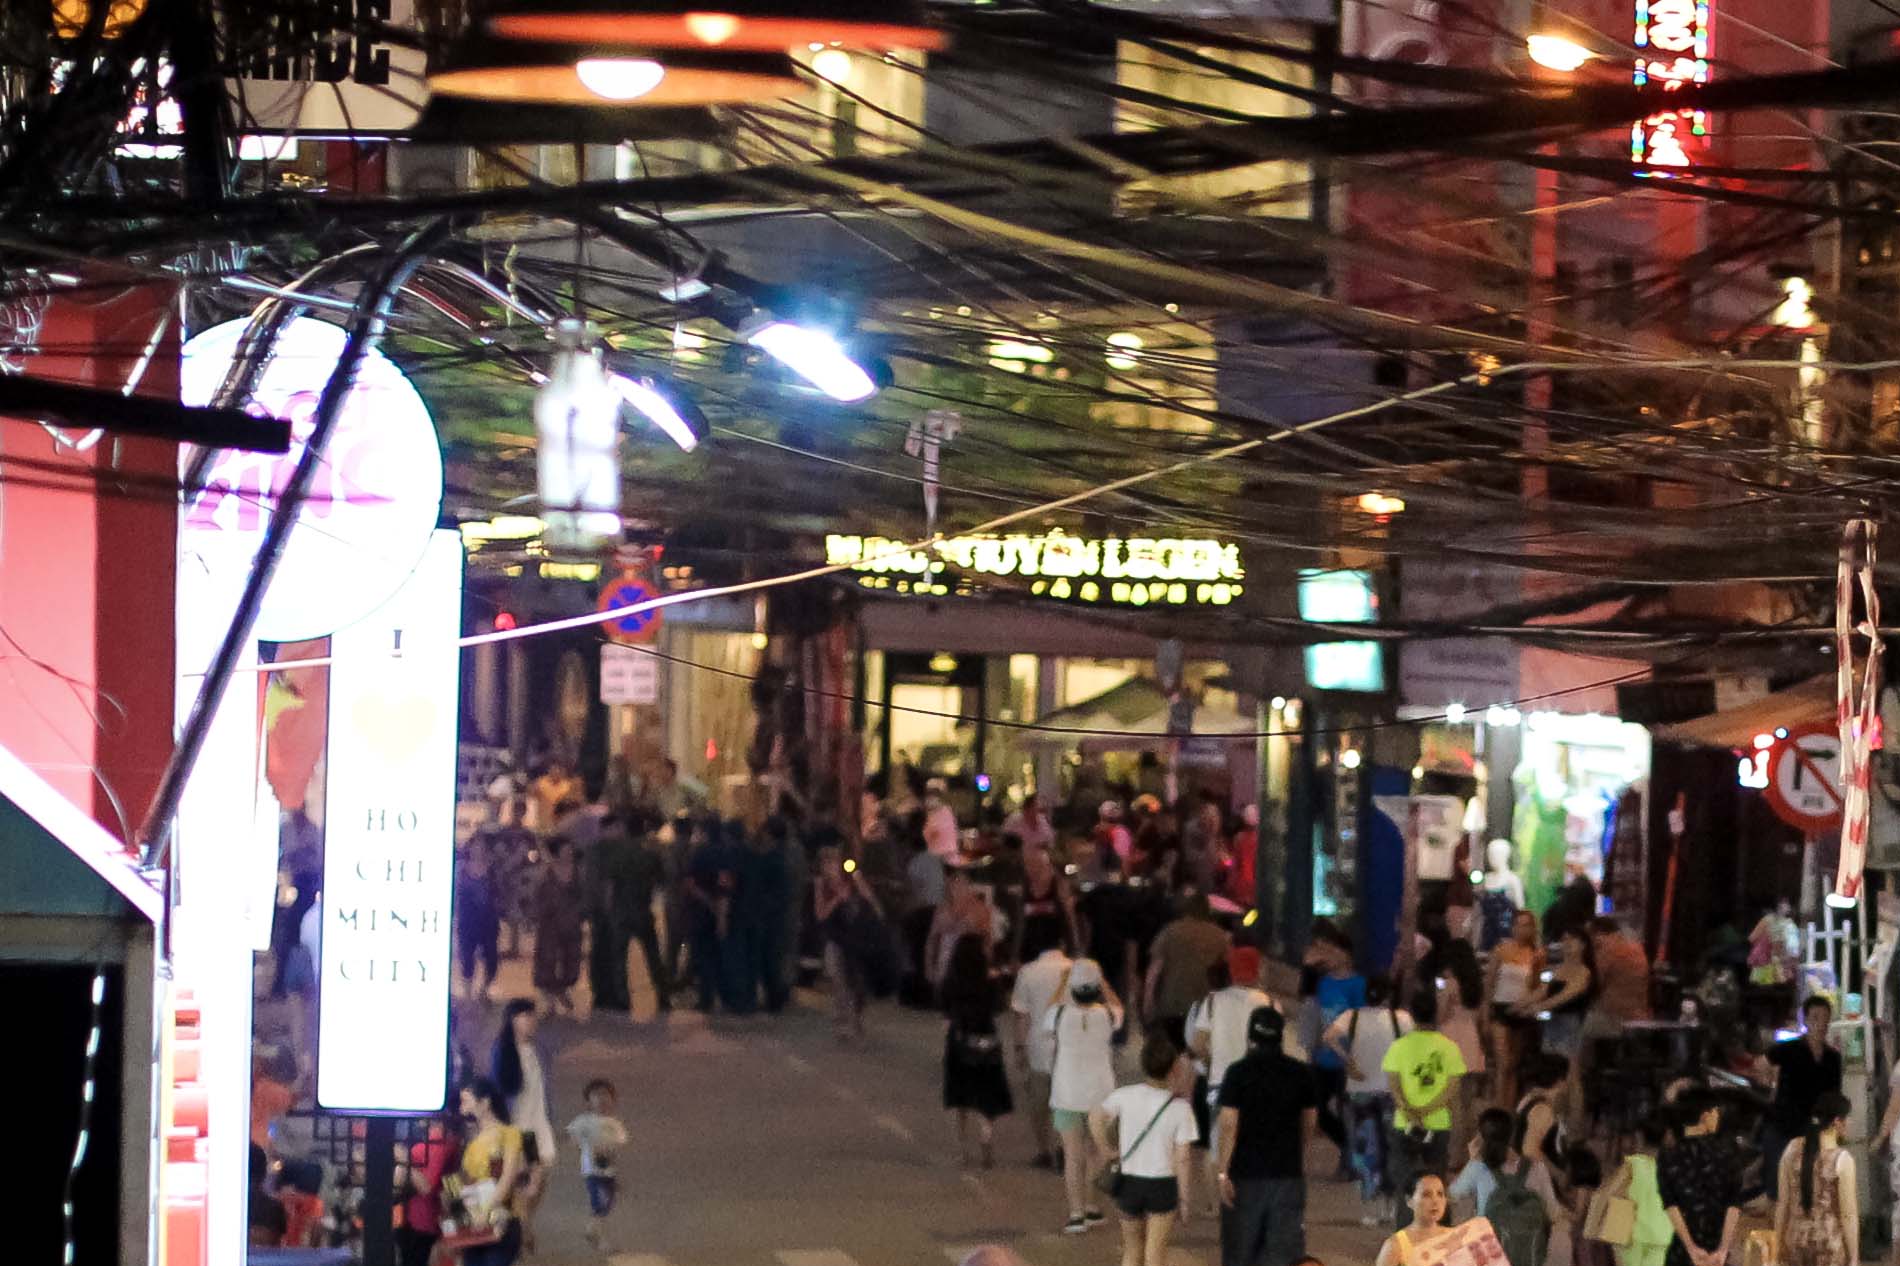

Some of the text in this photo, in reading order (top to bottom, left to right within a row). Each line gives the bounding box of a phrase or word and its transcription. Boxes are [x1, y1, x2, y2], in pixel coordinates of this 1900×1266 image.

[391, 629, 403, 658] I
[367, 809, 417, 831] HO
[355, 860, 423, 882] CHI
[339, 908, 438, 933] MINH
[339, 959, 426, 982] CITY
